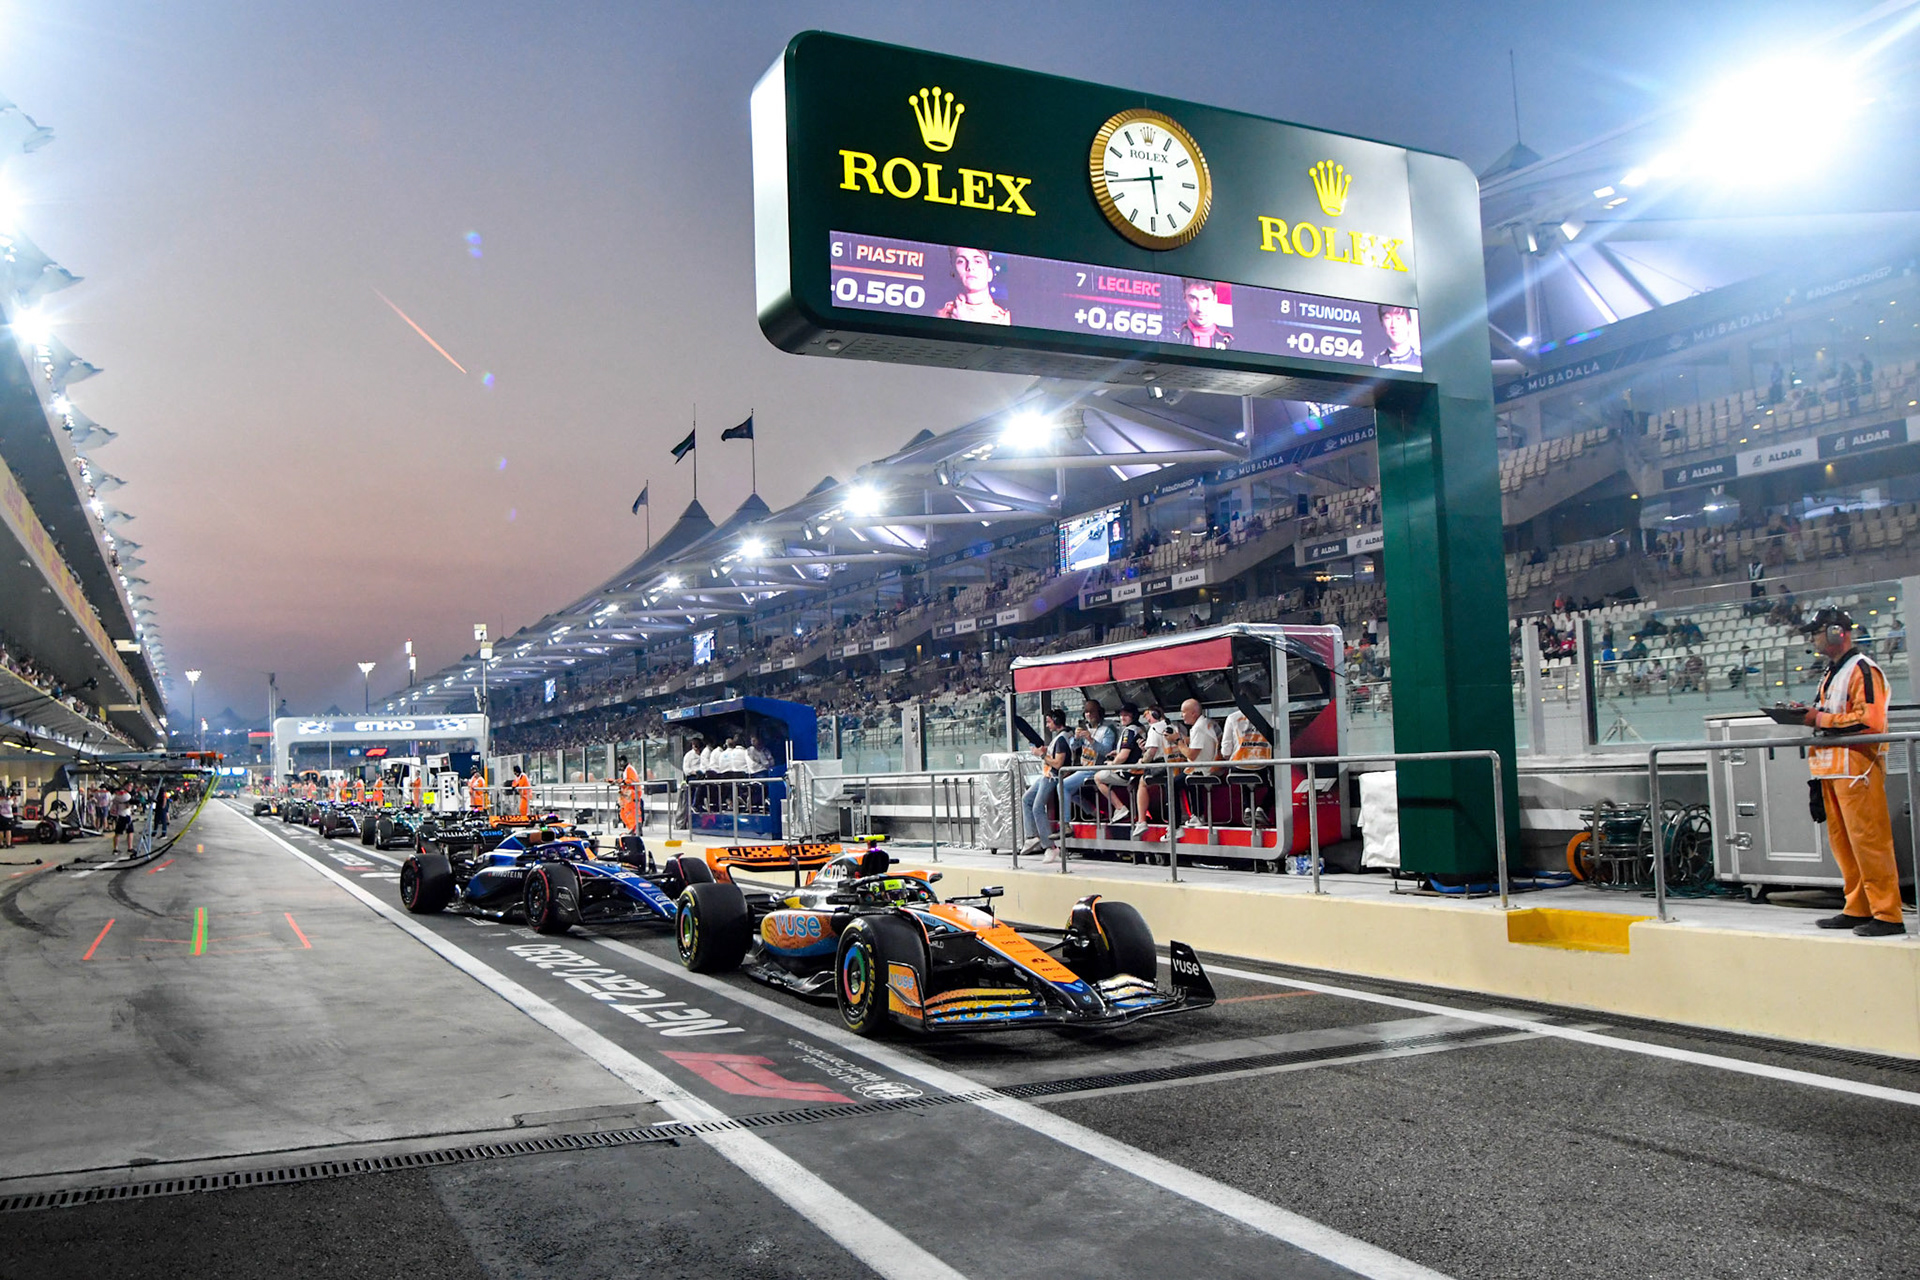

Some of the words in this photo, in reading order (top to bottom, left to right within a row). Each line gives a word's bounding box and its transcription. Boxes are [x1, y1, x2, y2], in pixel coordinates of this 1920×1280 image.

[1129, 149, 1169, 164] ROLEX
[839, 149, 1037, 217] ROLEX
[831, 241, 844, 257] 6
[856, 244, 924, 268] PIASTRI
[1258, 215, 1409, 272] ROLEX
[1075, 272, 1087, 287] 7
[1098, 275, 1162, 297] LECLERC
[1074, 306, 1163, 336] +0.665
[1280, 300, 1290, 314] 8
[1299, 303, 1362, 323] TSUNODA
[1692, 307, 1784, 342] MUBADALA
[1287, 333, 1364, 360] +0.694
[1528, 361, 1600, 390] MUBADALA
[1340, 428, 1375, 446] MUBAD
[1852, 429, 1891, 446] ALDAR
[1238, 456, 1284, 476] MUBADALA
[1768, 449, 1802, 463] ALDAR
[1692, 464, 1724, 479] ALDAR
[354, 719, 416, 731] ETIHAD
[506, 943, 601, 969] 2030
[552, 968, 667, 1001] ZERO
[608, 1001, 746, 1037] NET
